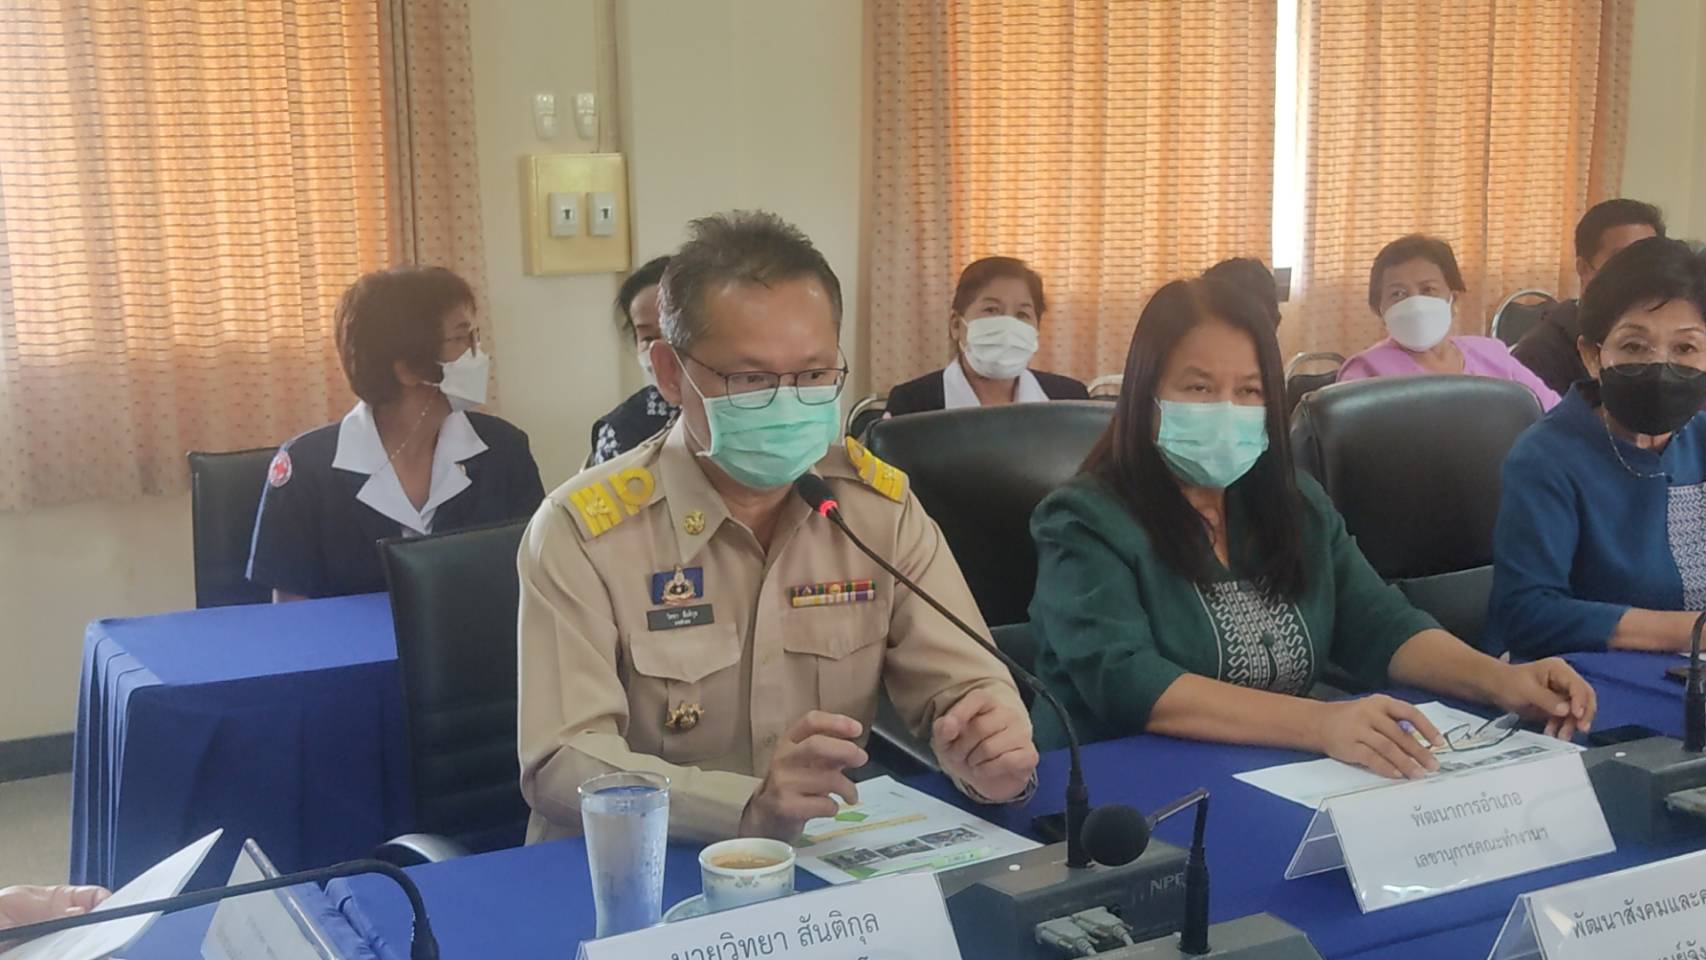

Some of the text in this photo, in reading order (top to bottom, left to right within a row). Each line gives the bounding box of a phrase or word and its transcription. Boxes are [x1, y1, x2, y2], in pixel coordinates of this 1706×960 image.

[1411, 791, 1523, 828] พัฒนาการอำเภอ
[797, 909, 880, 947] สันติกุล
